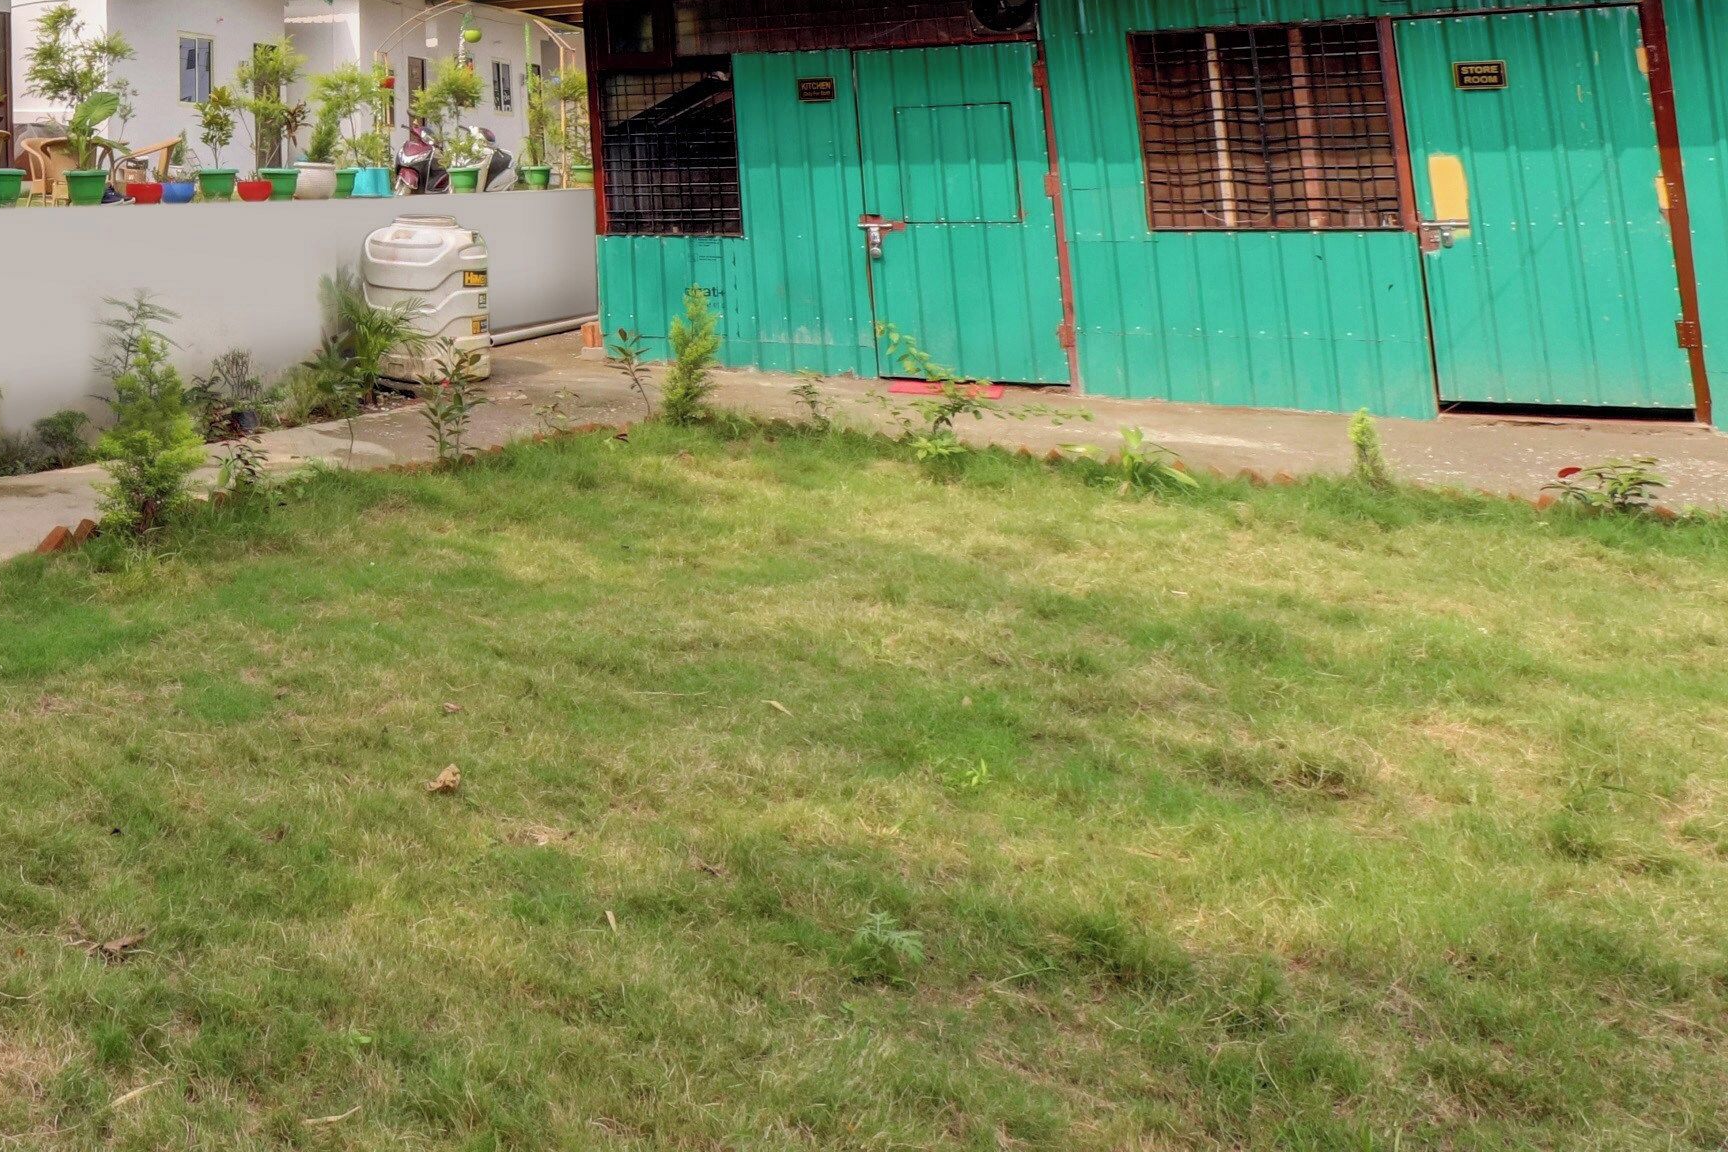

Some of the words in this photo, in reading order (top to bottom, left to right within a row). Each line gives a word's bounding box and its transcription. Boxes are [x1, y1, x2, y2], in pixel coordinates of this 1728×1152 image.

[1461, 65, 1499, 75] STORE
[1464, 76, 1498, 84] ROOM
[801, 81, 832, 90] KITCHEN
